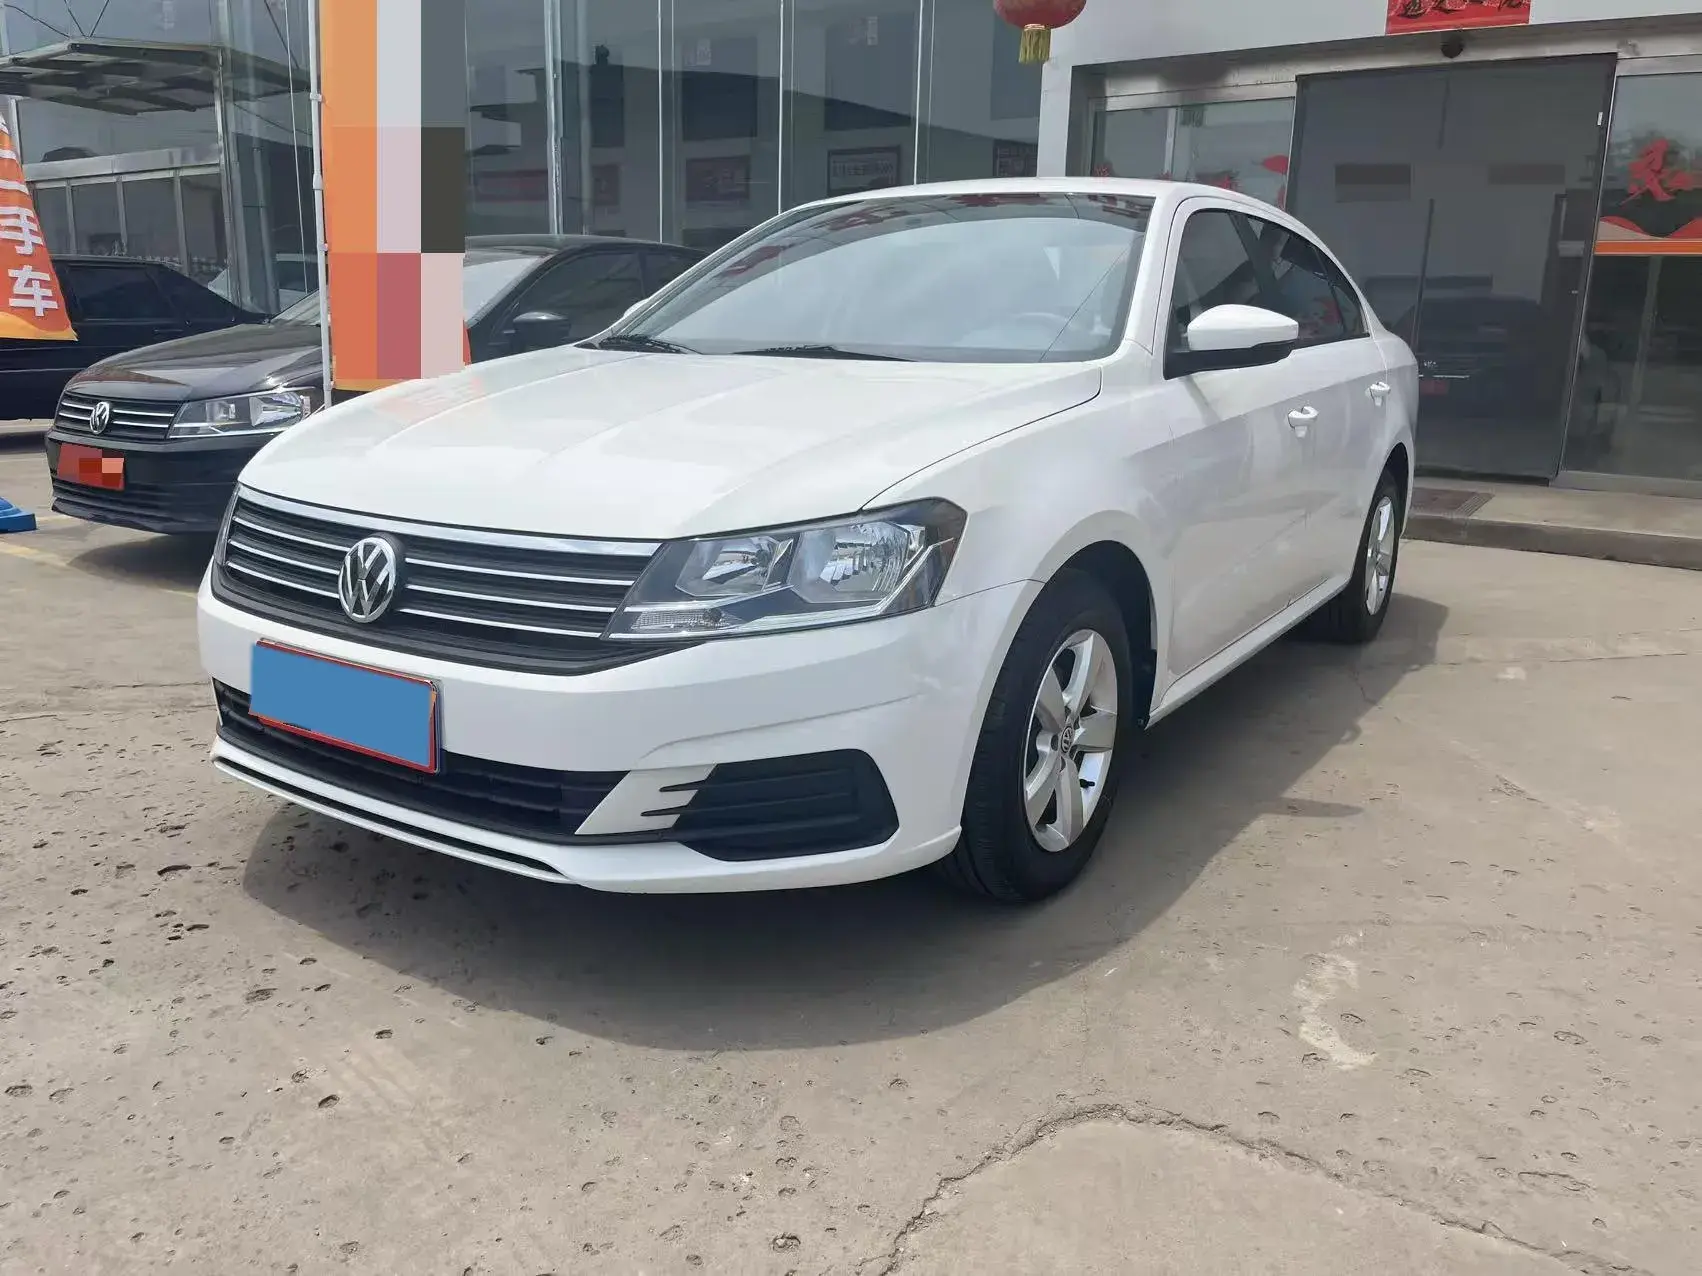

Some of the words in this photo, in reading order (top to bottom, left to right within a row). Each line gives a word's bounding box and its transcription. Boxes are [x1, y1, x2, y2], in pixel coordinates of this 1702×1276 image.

[0, 115, 58, 317] 二手车
[340, 538, 395, 621] VW
